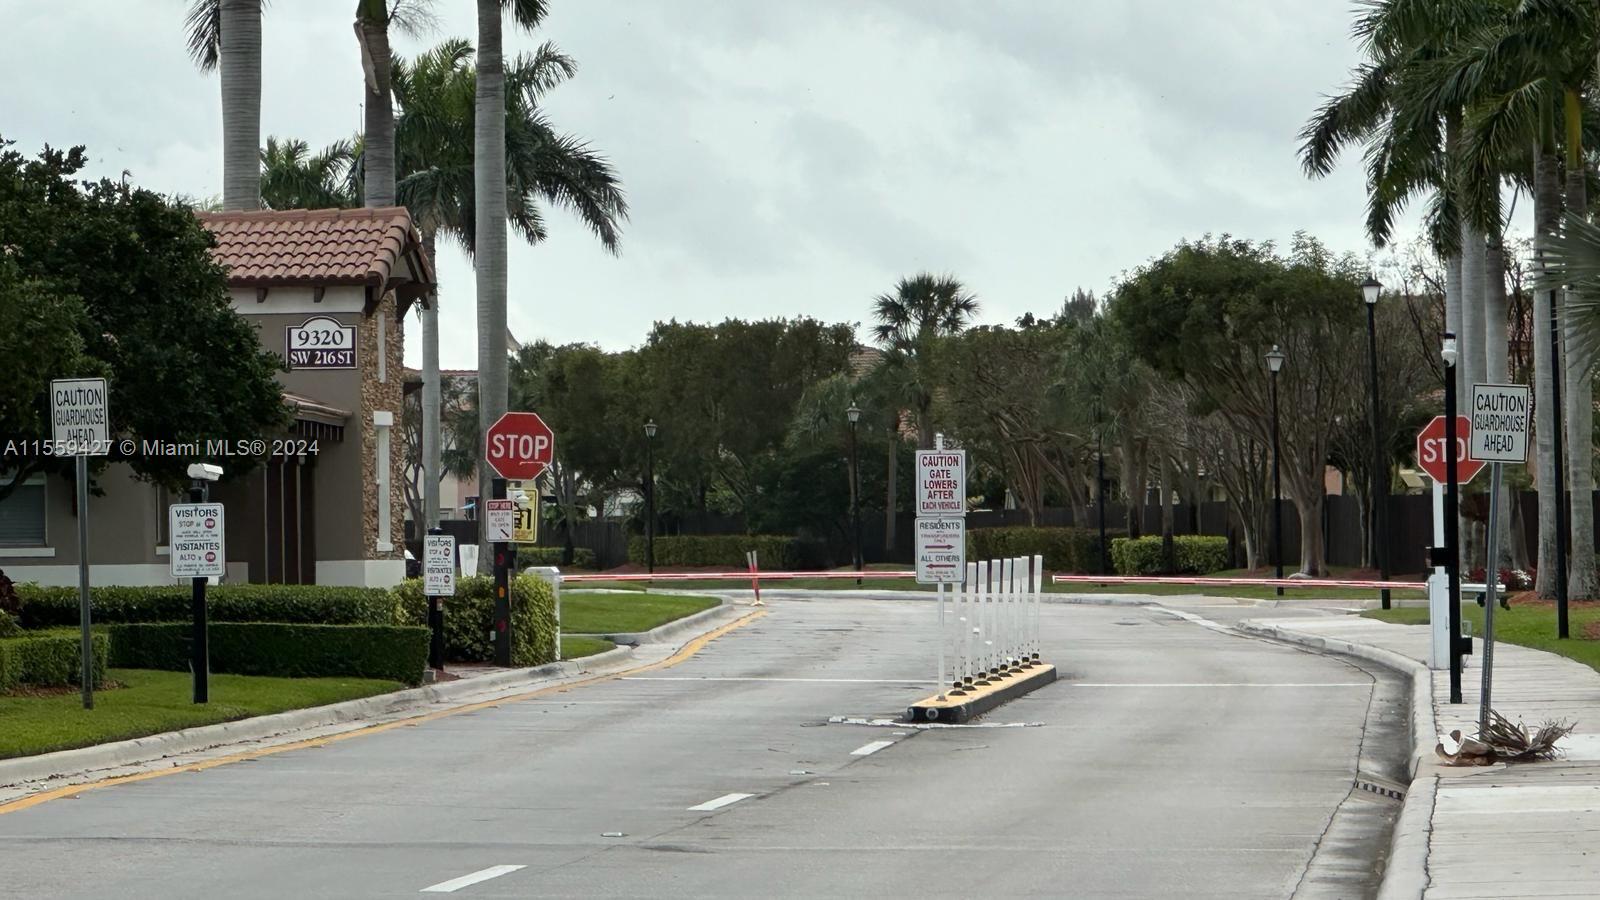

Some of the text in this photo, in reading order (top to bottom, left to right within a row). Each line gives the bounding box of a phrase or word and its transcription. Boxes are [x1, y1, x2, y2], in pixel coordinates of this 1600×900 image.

[298, 330, 344, 346] 9320
[291, 351, 353, 365] SW 216 ST
[56, 389, 102, 406] CAUTION
[1476, 394, 1525, 412] CAUTION
[56, 408, 104, 426] GUARDHOUSE
[1474, 414, 1525, 432] GUARDHOUSE
[67, 428, 95, 447] AHEAD
[491, 434, 548, 460] STOP
[1424, 437, 1467, 463] STO
[1484, 435, 1514, 453] AHEAD
[922, 456, 959, 467] CAUTION
[929, 469, 951, 479] GATE
[924, 480, 957, 489] LOWERS
[927, 490, 954, 500] AFTER
[922, 501, 961, 510] EACH VEHICLE
[176, 508, 218, 518] VISITORS
[178, 520, 195, 528] STOP
[920, 522, 961, 530] RESIDENTS
[175, 542, 220, 551] VISITANTES
[920, 554, 961, 562] ALL OTHERS
